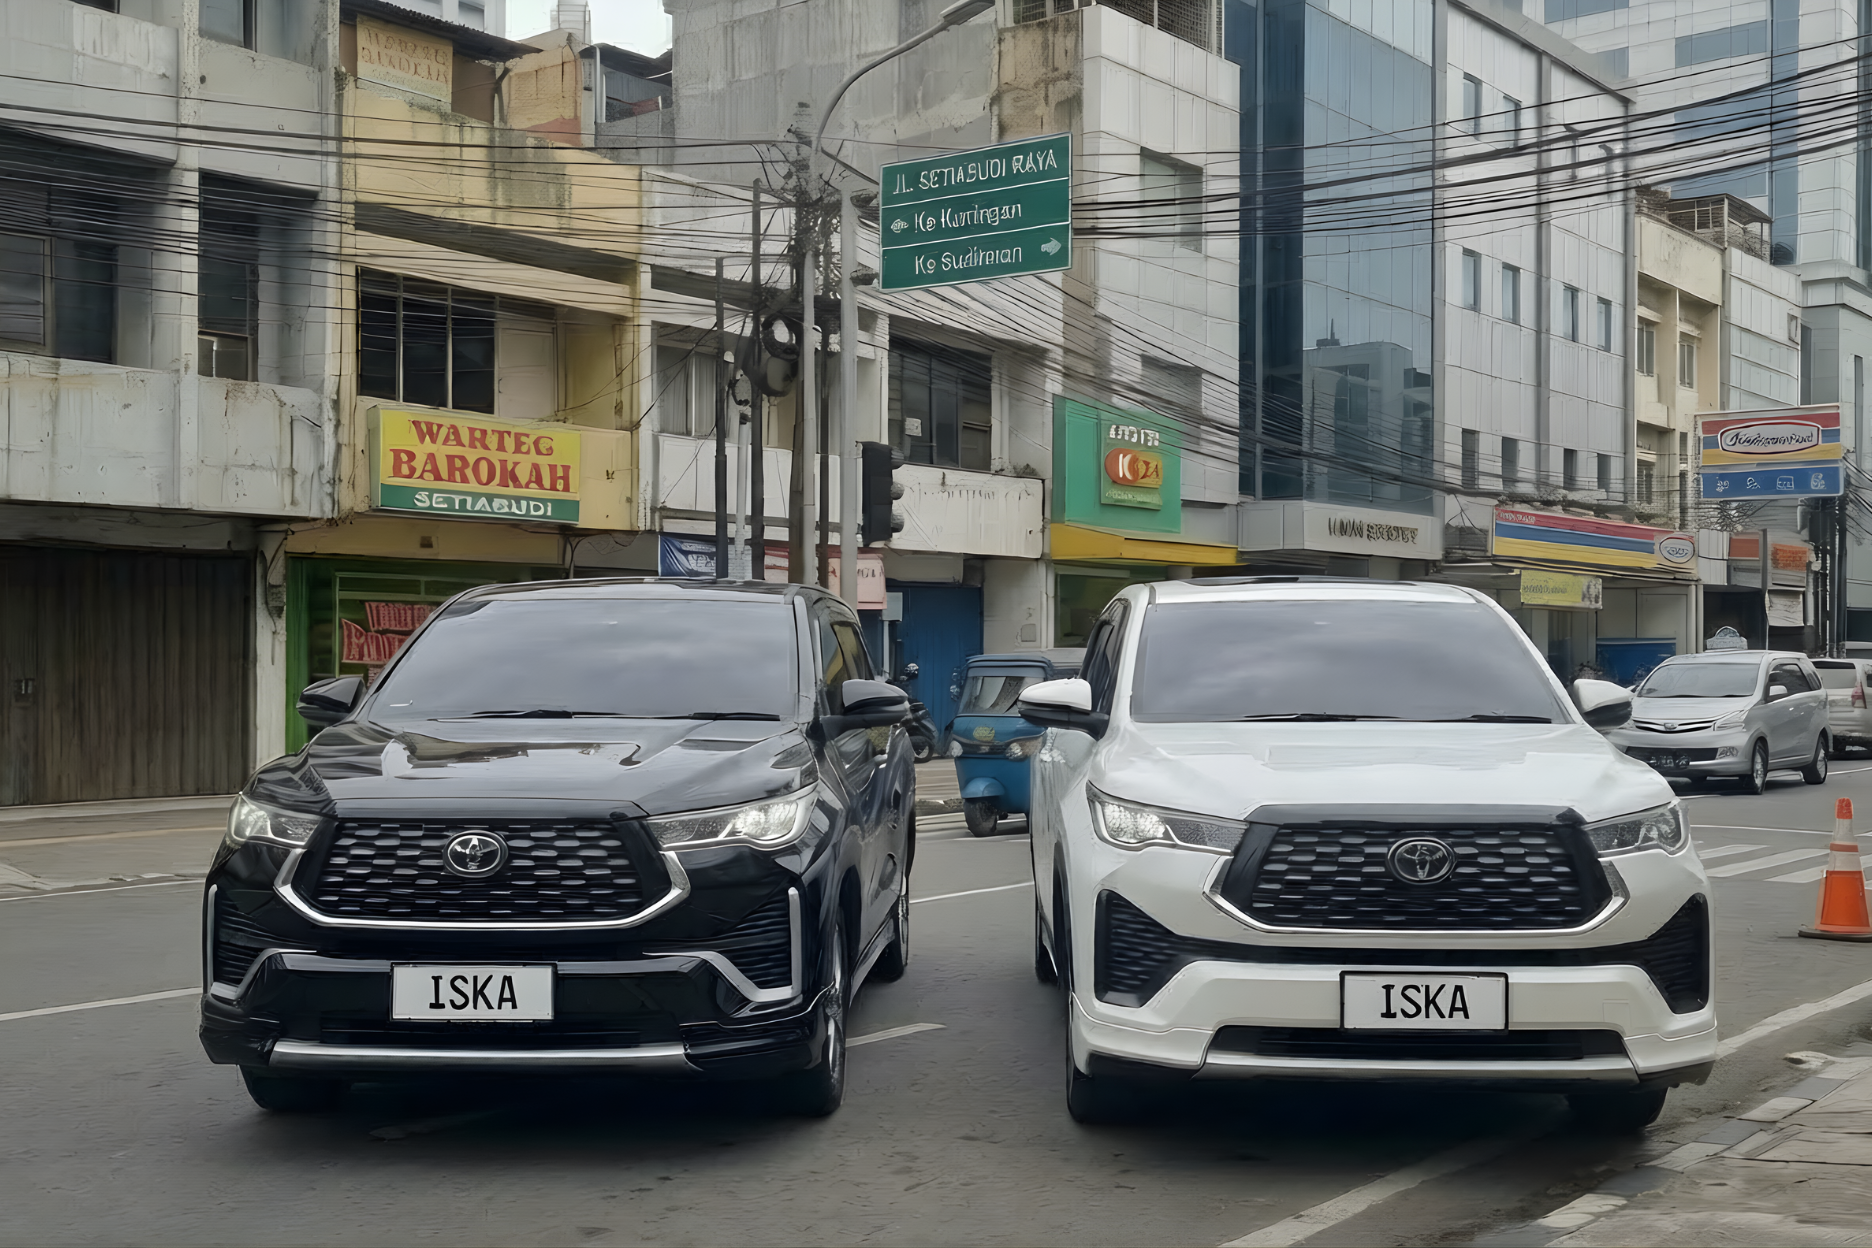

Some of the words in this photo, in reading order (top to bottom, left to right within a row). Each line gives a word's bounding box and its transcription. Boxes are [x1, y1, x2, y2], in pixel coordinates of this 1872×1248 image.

[1012, 149, 1058, 174] RAYA
[389, 448, 571, 492] BAROKAH
[413, 491, 552, 516] SETIABUDI
[429, 974, 518, 1010] ISKA
[1380, 983, 1470, 1019] ISKA
